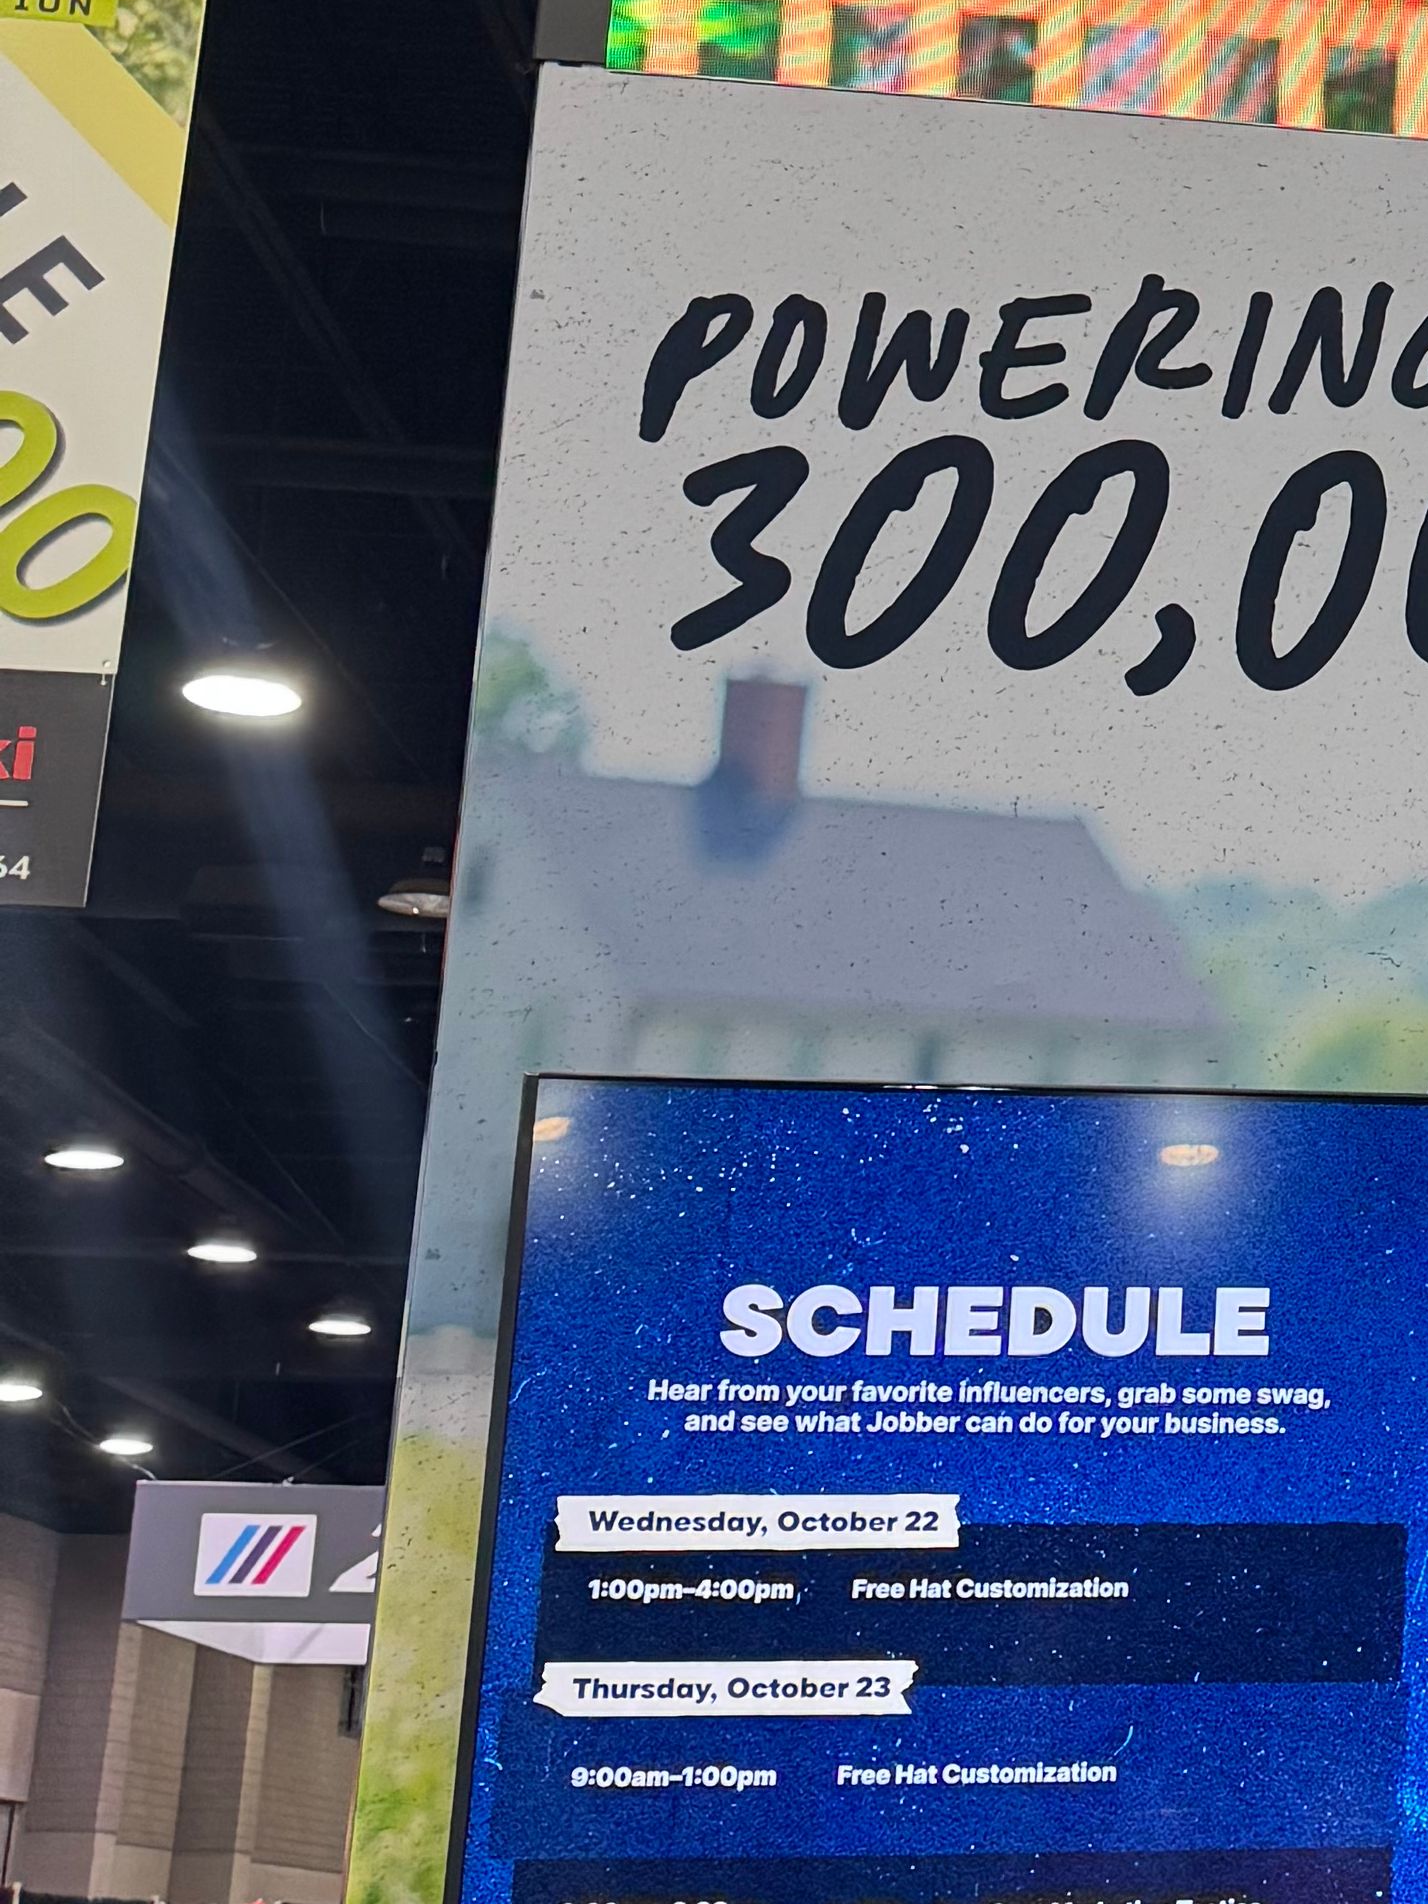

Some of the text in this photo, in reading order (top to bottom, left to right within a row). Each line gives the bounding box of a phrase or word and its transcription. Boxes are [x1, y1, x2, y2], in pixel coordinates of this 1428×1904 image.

[719, 1284, 1271, 1358] SCHEDULE
[648, 1378, 1332, 1411] Hear from your favorite influencers, grab some swag,
[684, 1409, 1287, 1439] and see what Jobber can do for your business.
[588, 1509, 940, 1537] Wednesday, October 22
[850, 1577, 906, 1600] Free
[908, 1577, 952, 1599] Hat
[956, 1575, 1130, 1600] Customization
[572, 1675, 892, 1705] Thursday, October 23
[836, 1765, 892, 1786] Free
[895, 1763, 939, 1786] Hat
[941, 1761, 1118, 1786] Customization
